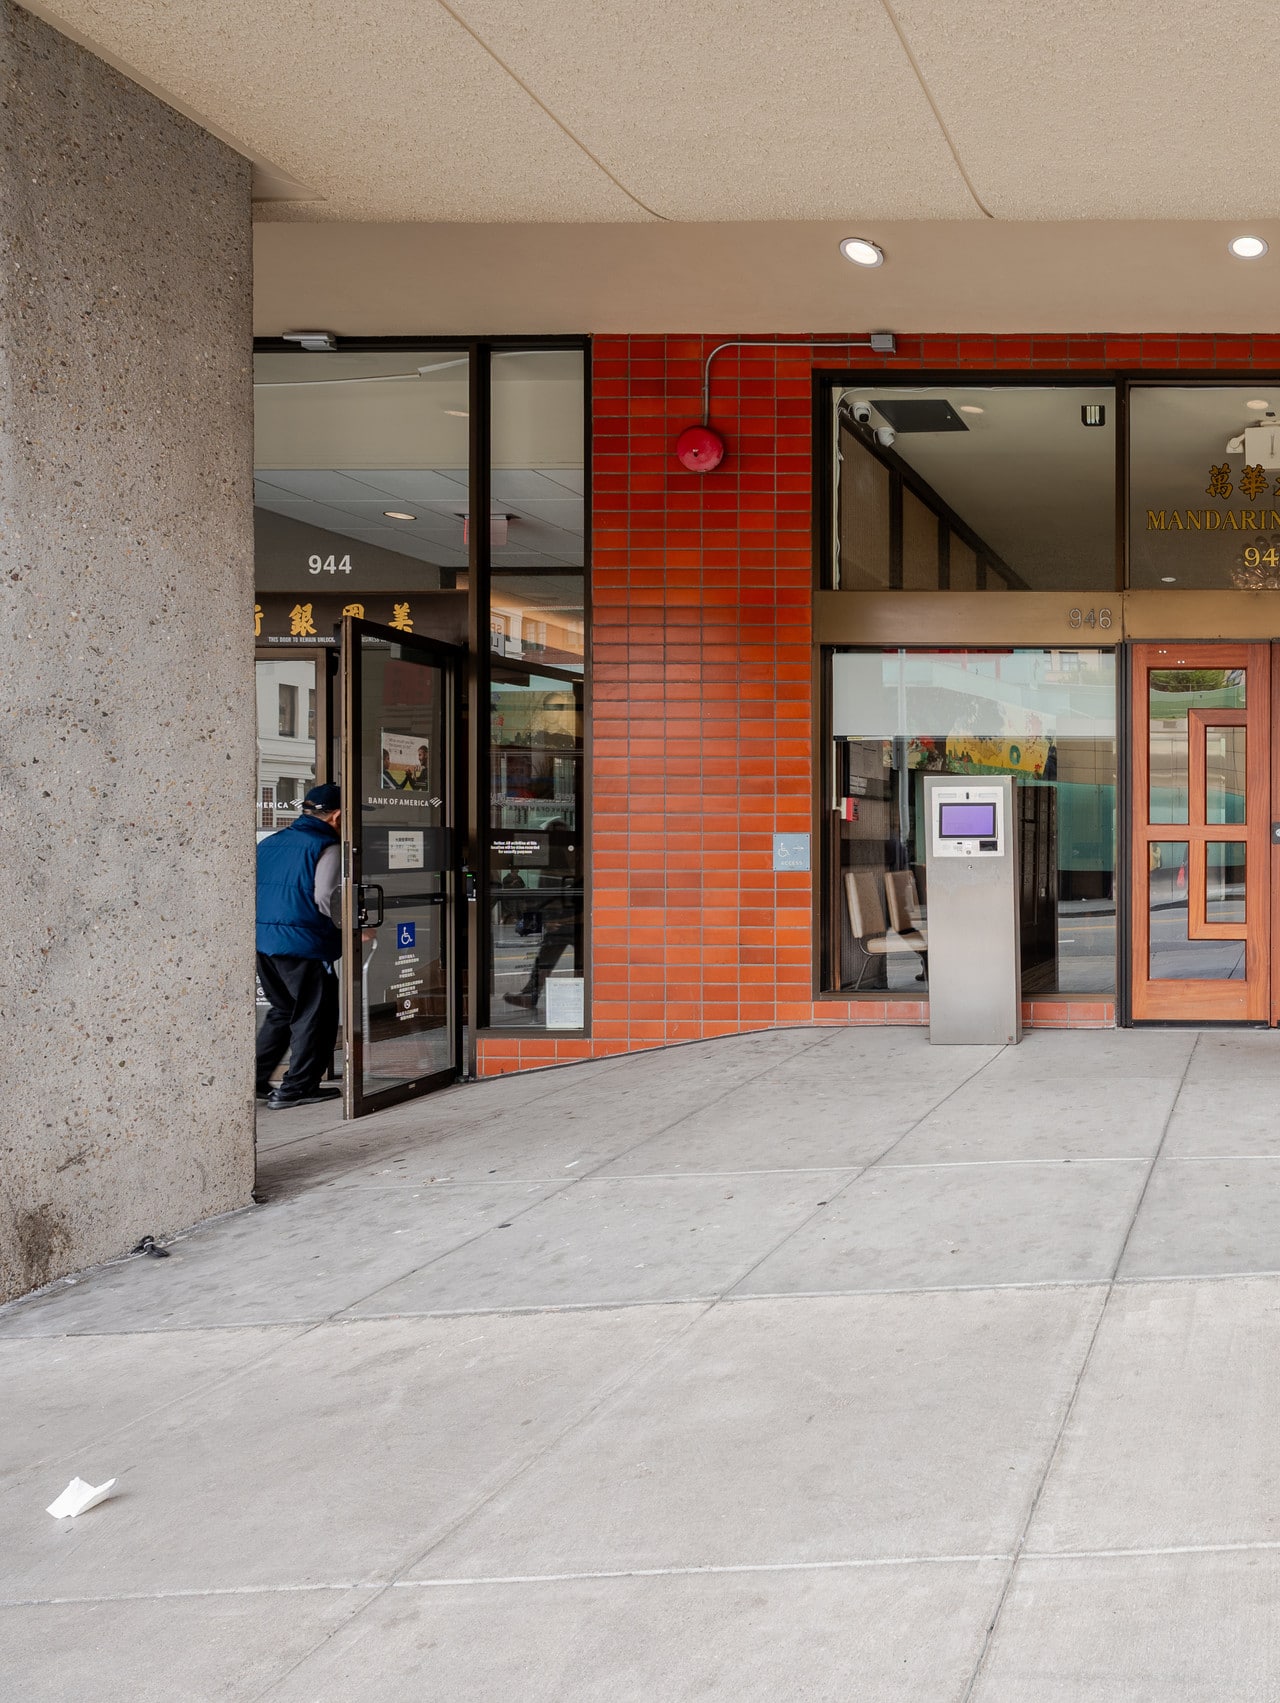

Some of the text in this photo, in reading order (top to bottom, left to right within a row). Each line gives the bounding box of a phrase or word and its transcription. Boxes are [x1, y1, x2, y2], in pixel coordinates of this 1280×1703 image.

[308, 555, 352, 574] 944
[1069, 607, 1113, 629] 946
[367, 796, 429, 808] BANK OF AMERICA
